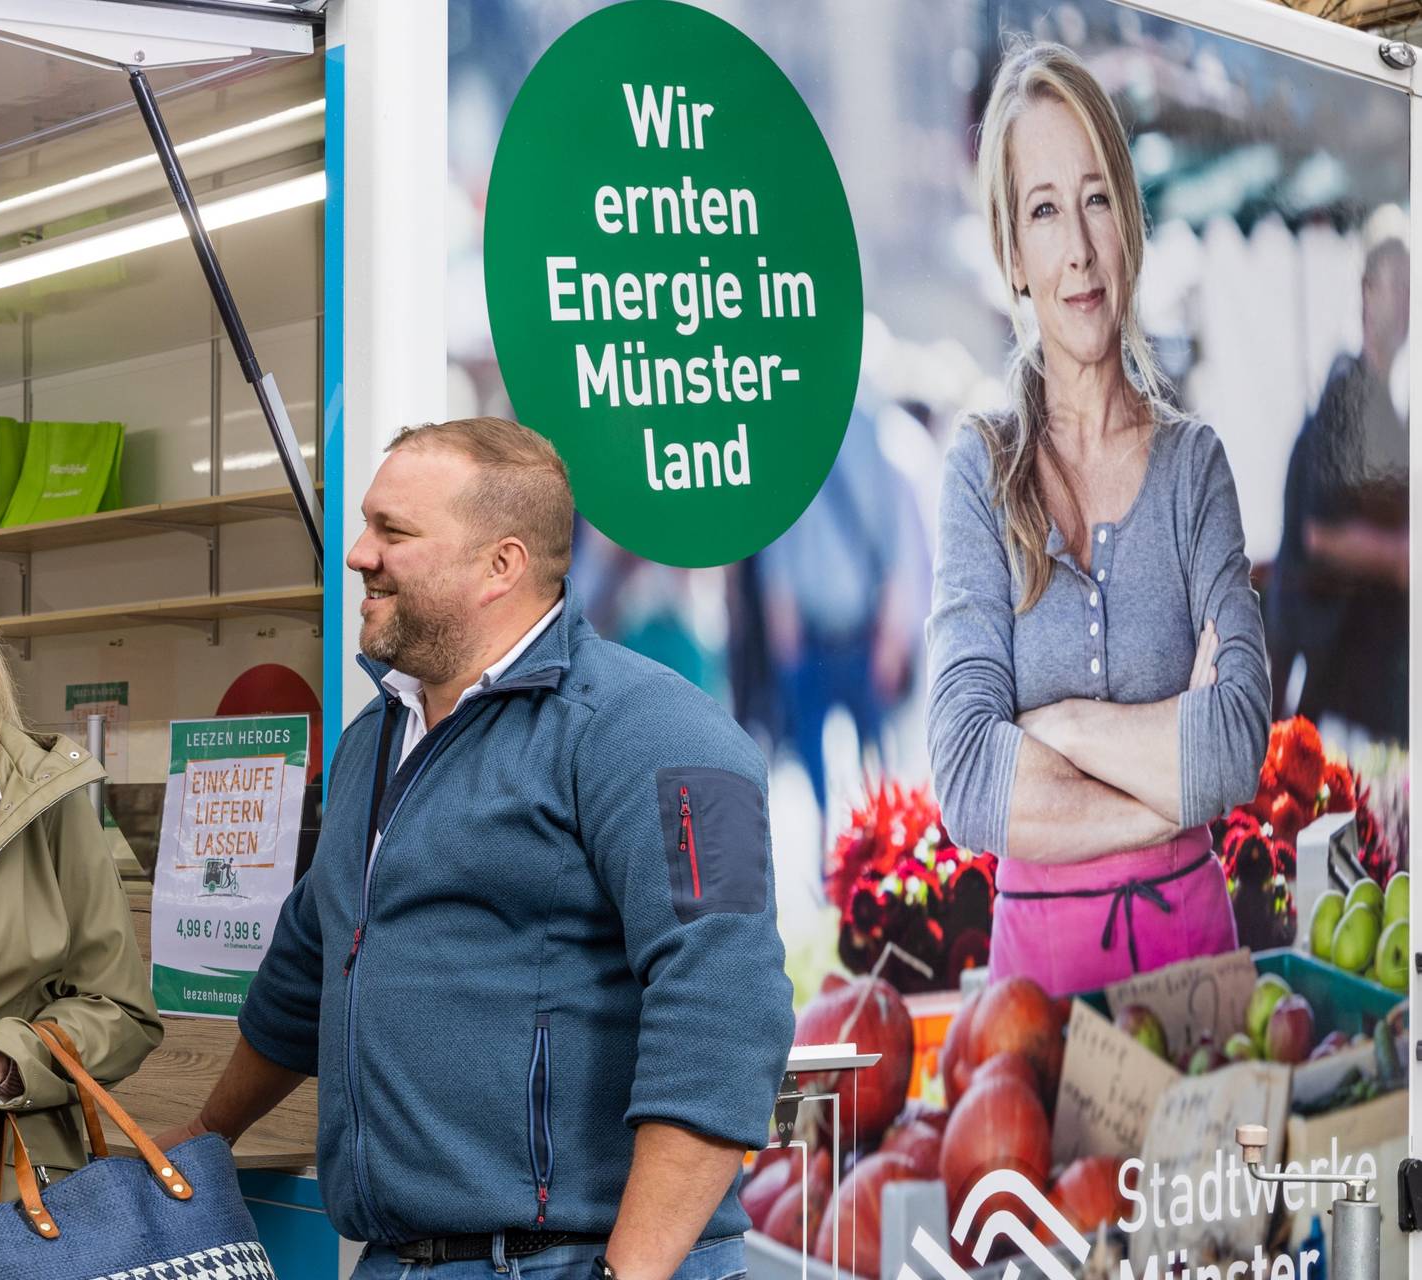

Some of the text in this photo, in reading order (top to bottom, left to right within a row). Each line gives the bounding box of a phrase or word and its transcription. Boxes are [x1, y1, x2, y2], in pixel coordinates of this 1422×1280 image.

[622, 83, 714, 150] Wir
[594, 176, 759, 235] ernten
[545, 256, 817, 336] Energie im
[575, 341, 800, 409] Münster-
[644, 424, 751, 491] land
[186, 729, 291, 747] LEEZEN HEROES
[192, 764, 275, 794] EINKÄUFE
[195, 800, 264, 825] LIEFERN
[195, 831, 259, 856] LASSEN
[176, 918, 201, 940] 4,99
[204, 919, 212, 938] €
[223, 921, 249, 942] 3,99
[252, 922, 261, 941] €
[183, 986, 247, 1004] leezenheroes.
[1117, 1136, 1377, 1233] Stadtwerke
